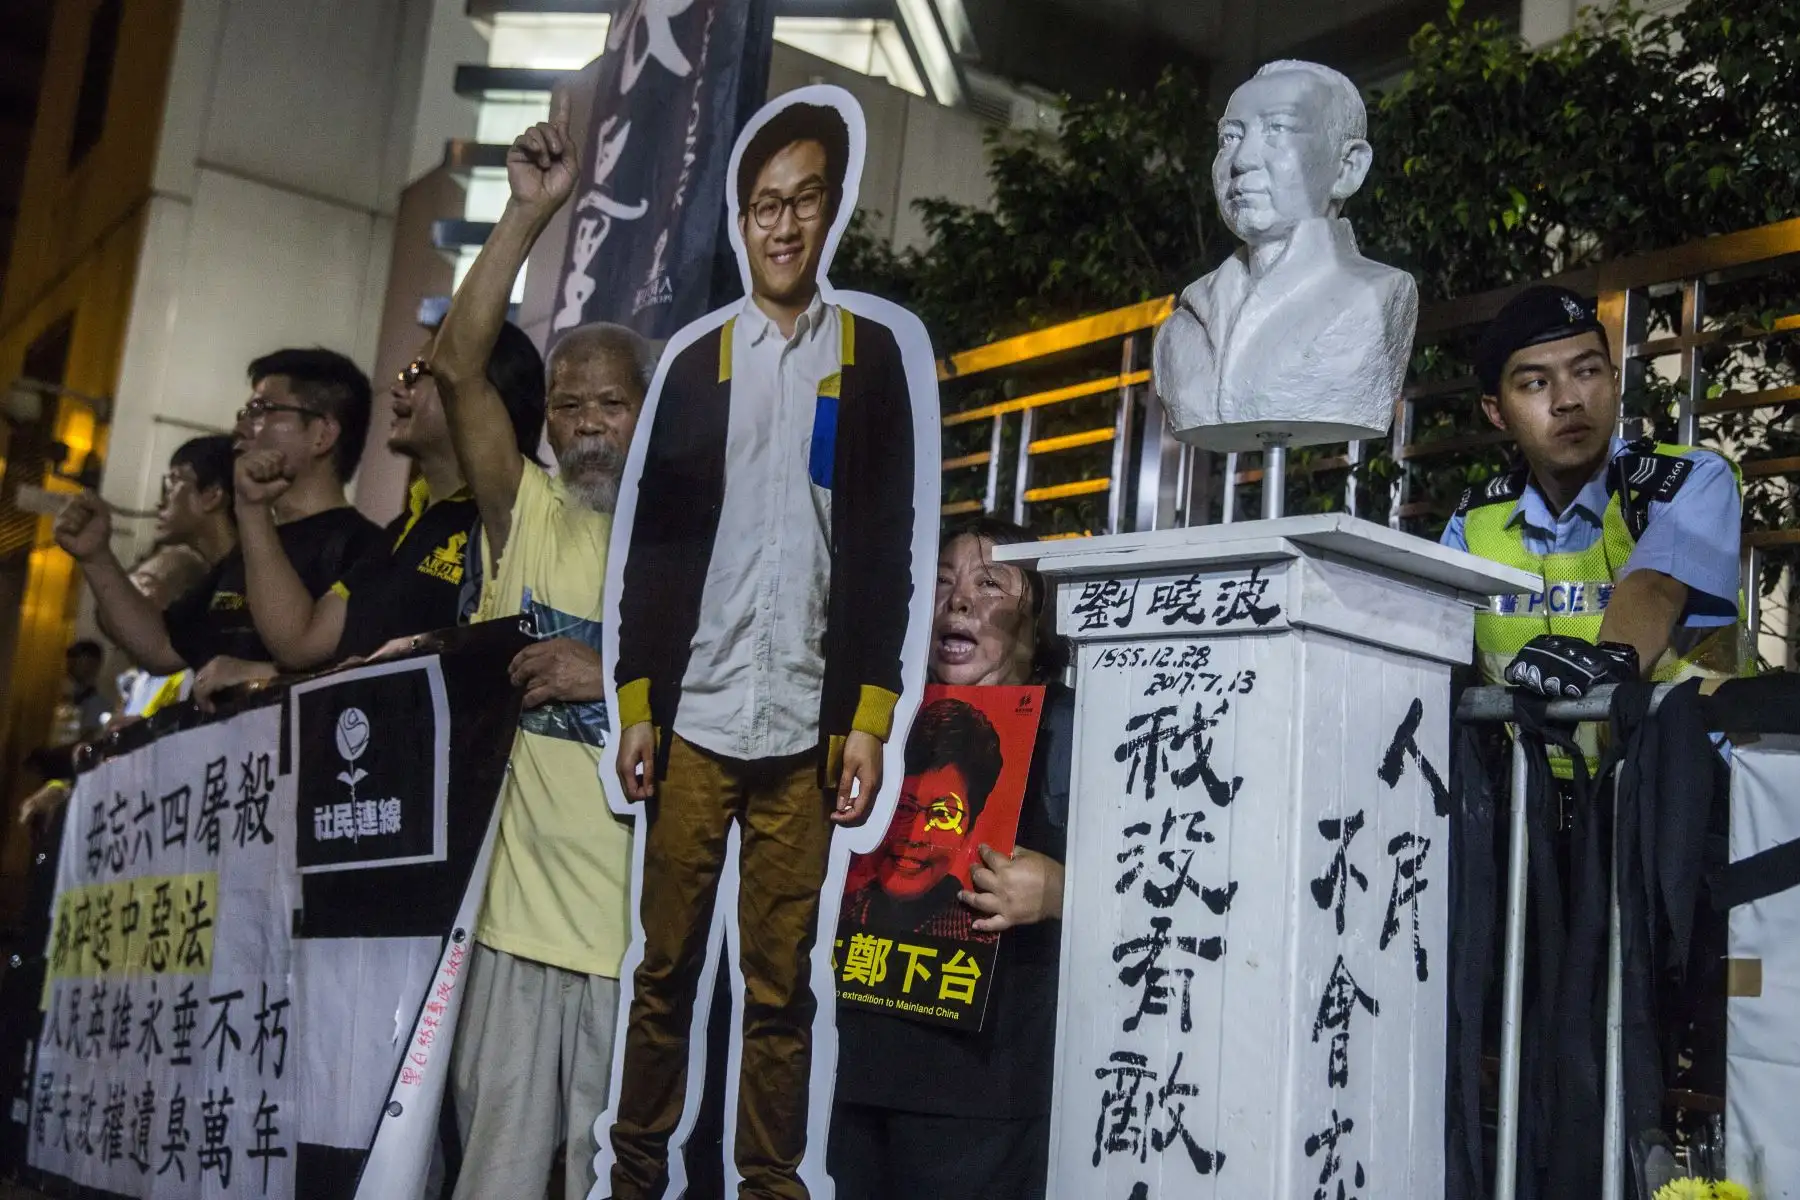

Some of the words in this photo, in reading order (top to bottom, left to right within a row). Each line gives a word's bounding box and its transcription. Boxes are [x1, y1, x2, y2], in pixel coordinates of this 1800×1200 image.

[1658, 461, 1685, 493] 17360
[314, 797, 402, 841] 社民連線
[830, 932, 982, 1005] 鄭下台
[842, 990, 885, 1007] extradition
[885, 997, 895, 1008] to
[895, 999, 935, 1016] Mainland
[935, 1005, 960, 1021] China
